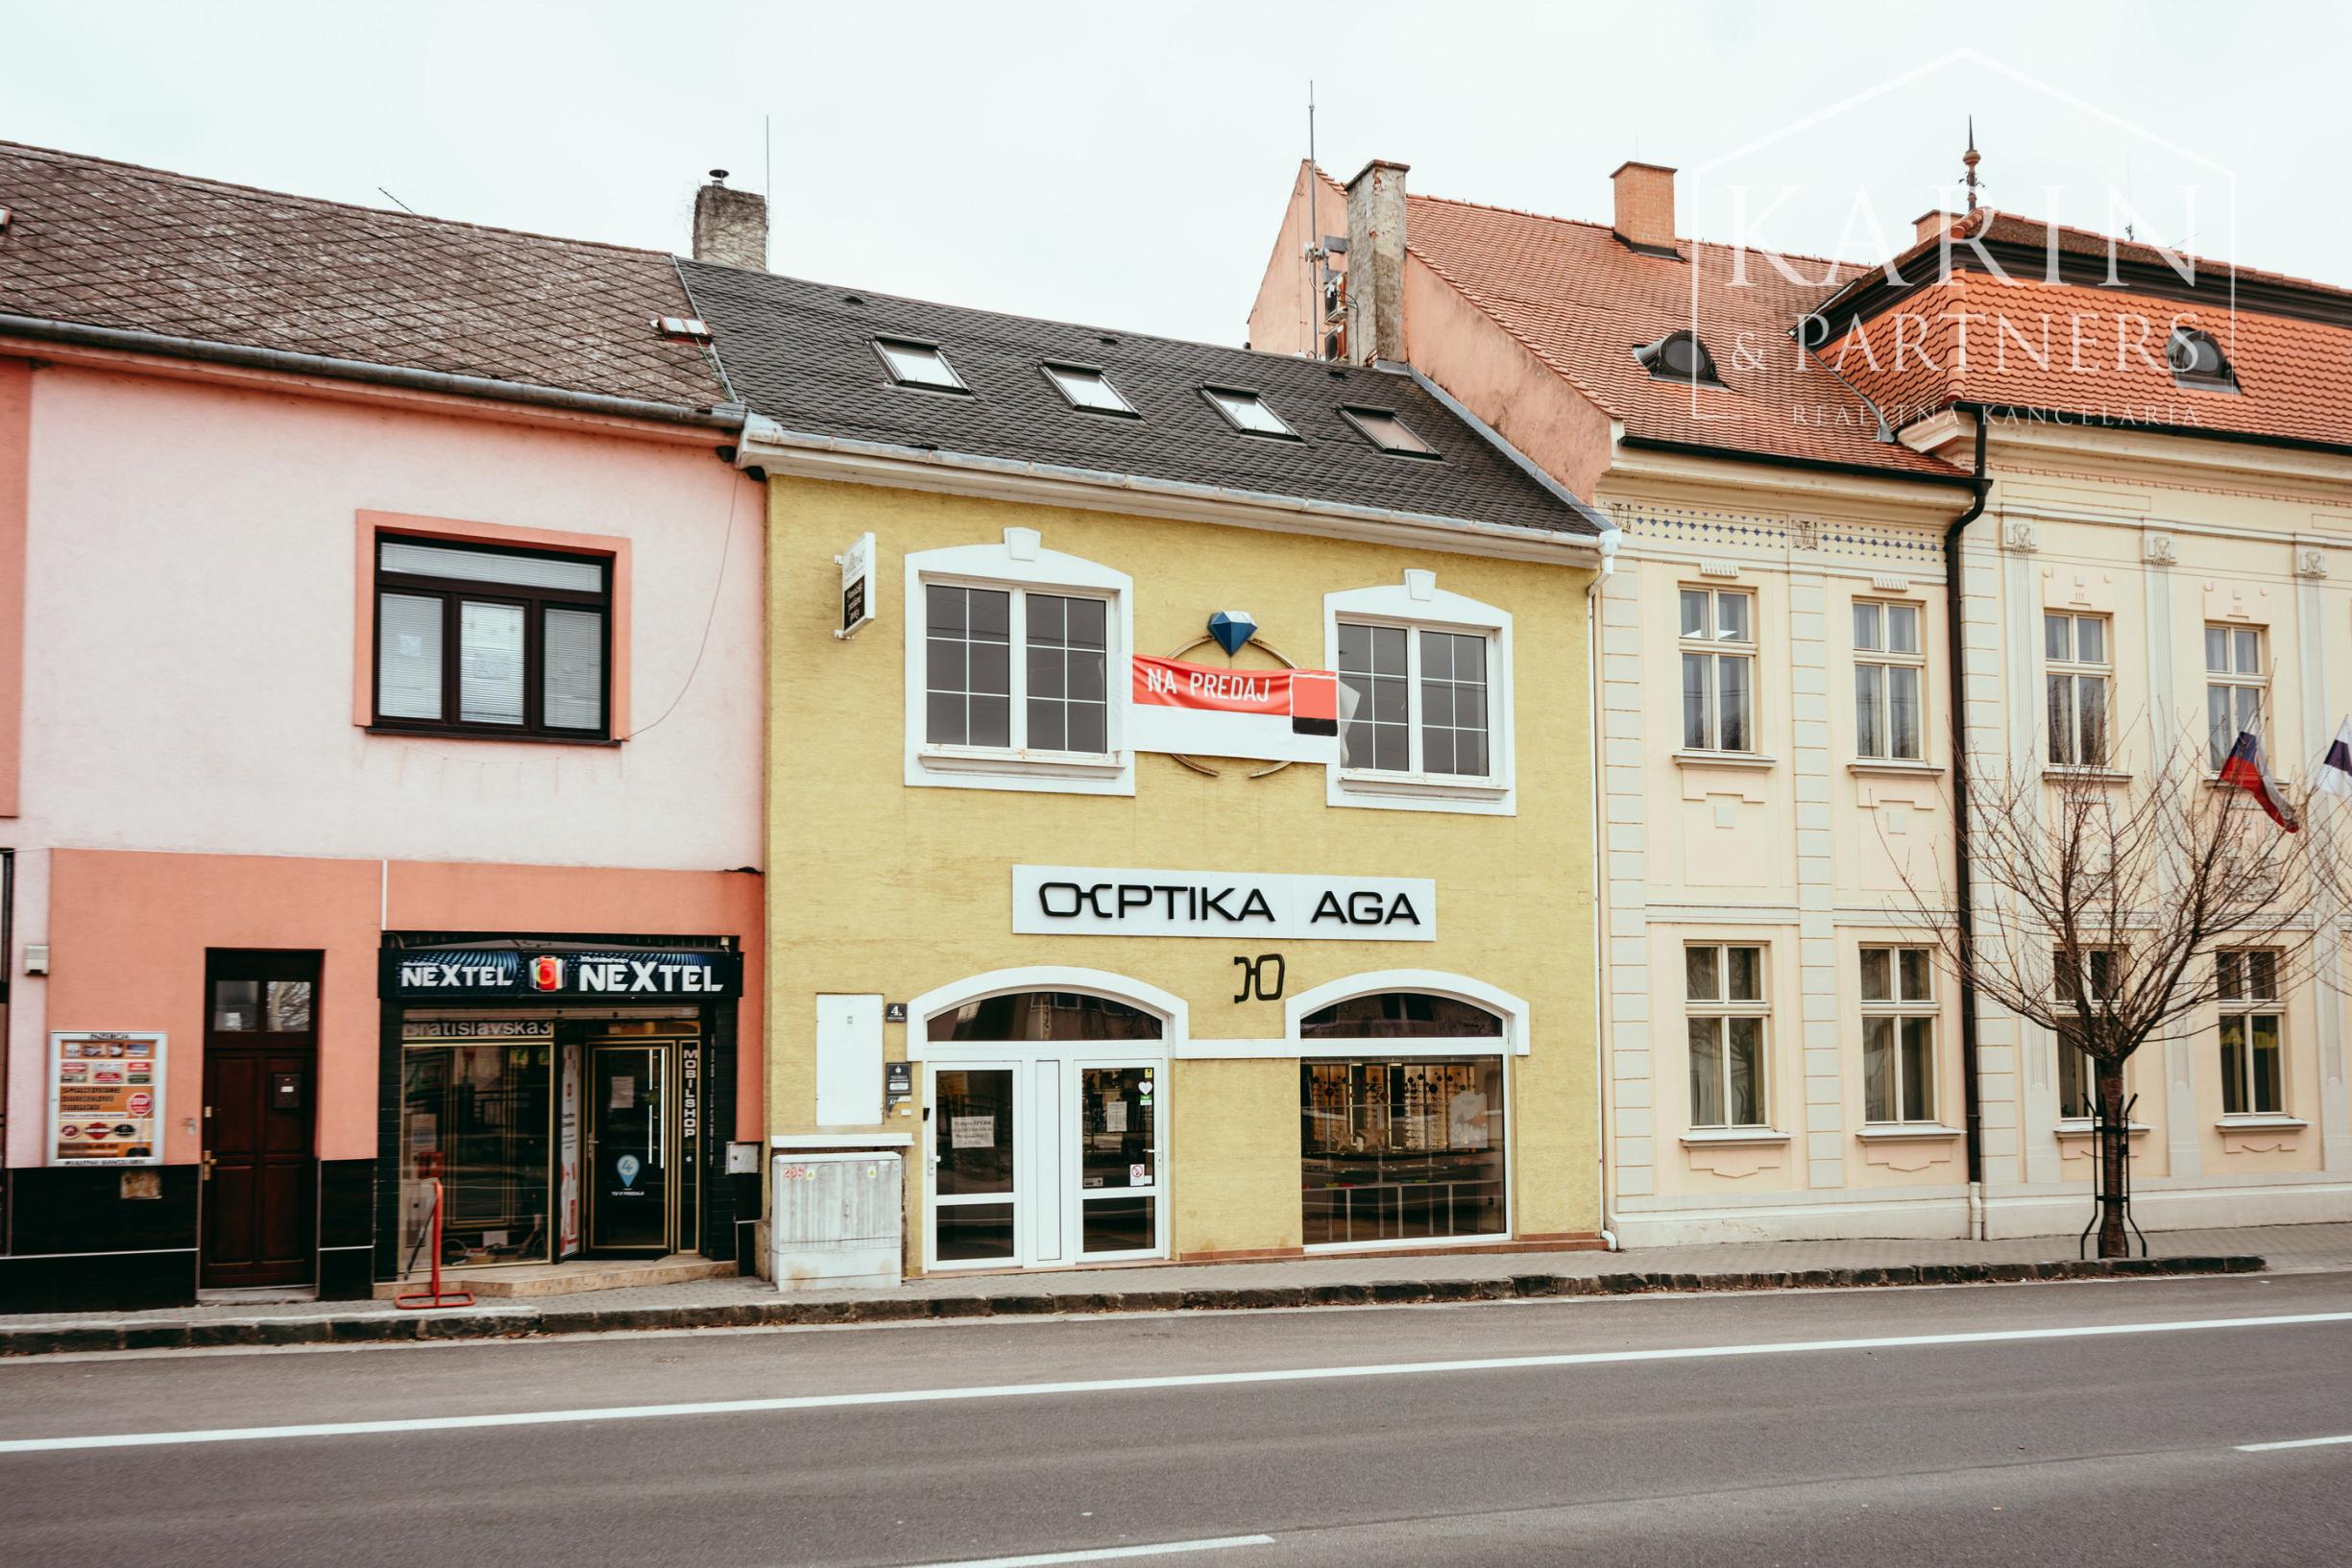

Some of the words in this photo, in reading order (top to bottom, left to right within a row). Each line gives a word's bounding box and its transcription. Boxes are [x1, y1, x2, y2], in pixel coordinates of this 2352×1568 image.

[1147, 668, 1177, 694] NA
[1190, 672, 1270, 703] PREDAJ
[1310, 890, 1421, 926] AGA
[400, 964, 514, 987] NEXTEL
[579, 961, 724, 992] NEXTEL
[683, 1049, 697, 1138] MOBILSHOP
